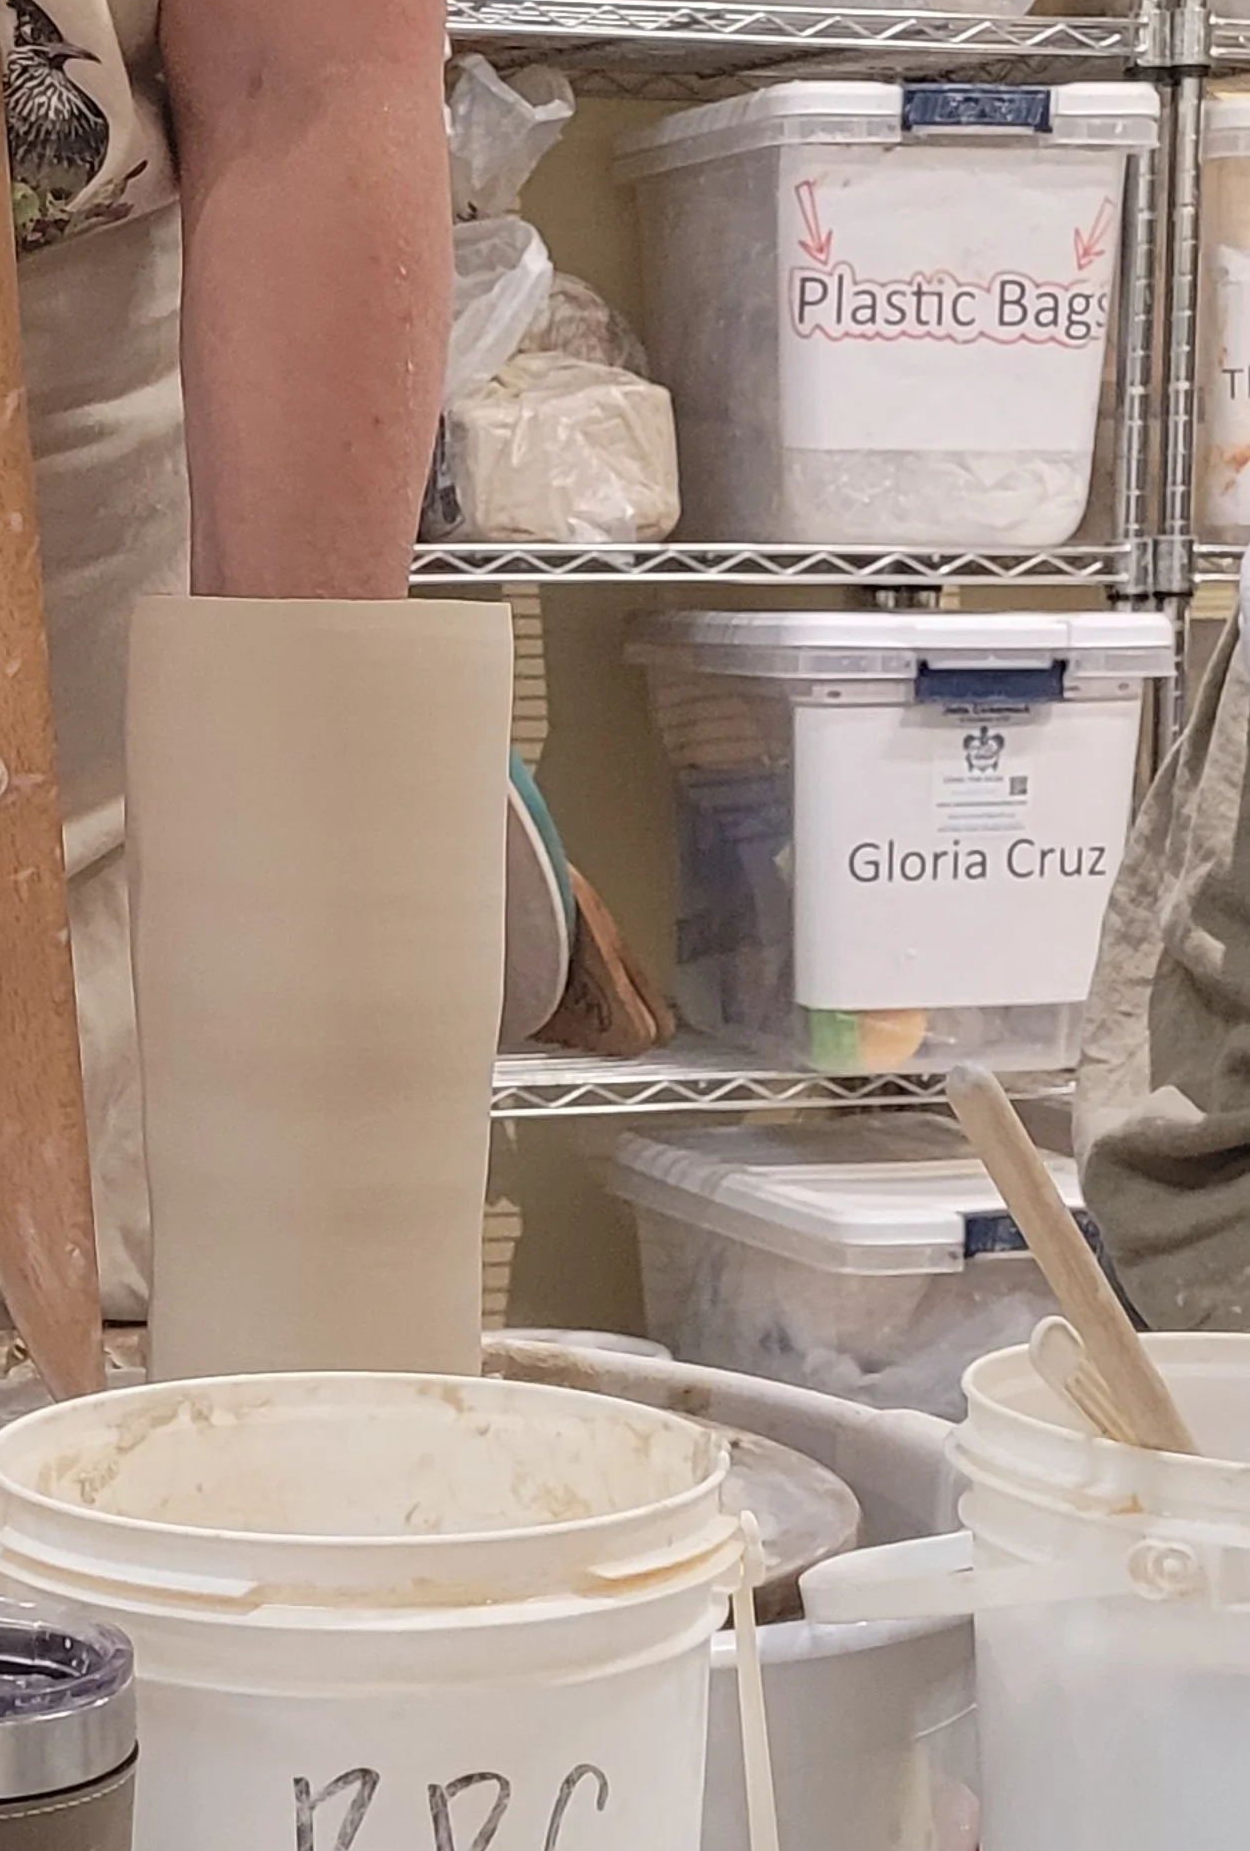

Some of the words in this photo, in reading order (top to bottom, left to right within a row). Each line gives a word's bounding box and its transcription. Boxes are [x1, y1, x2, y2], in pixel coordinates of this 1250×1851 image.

[798, 273, 977, 327] Plastic
[848, 839, 987, 882] Gloria
[1007, 838, 1107, 878] Cruz
